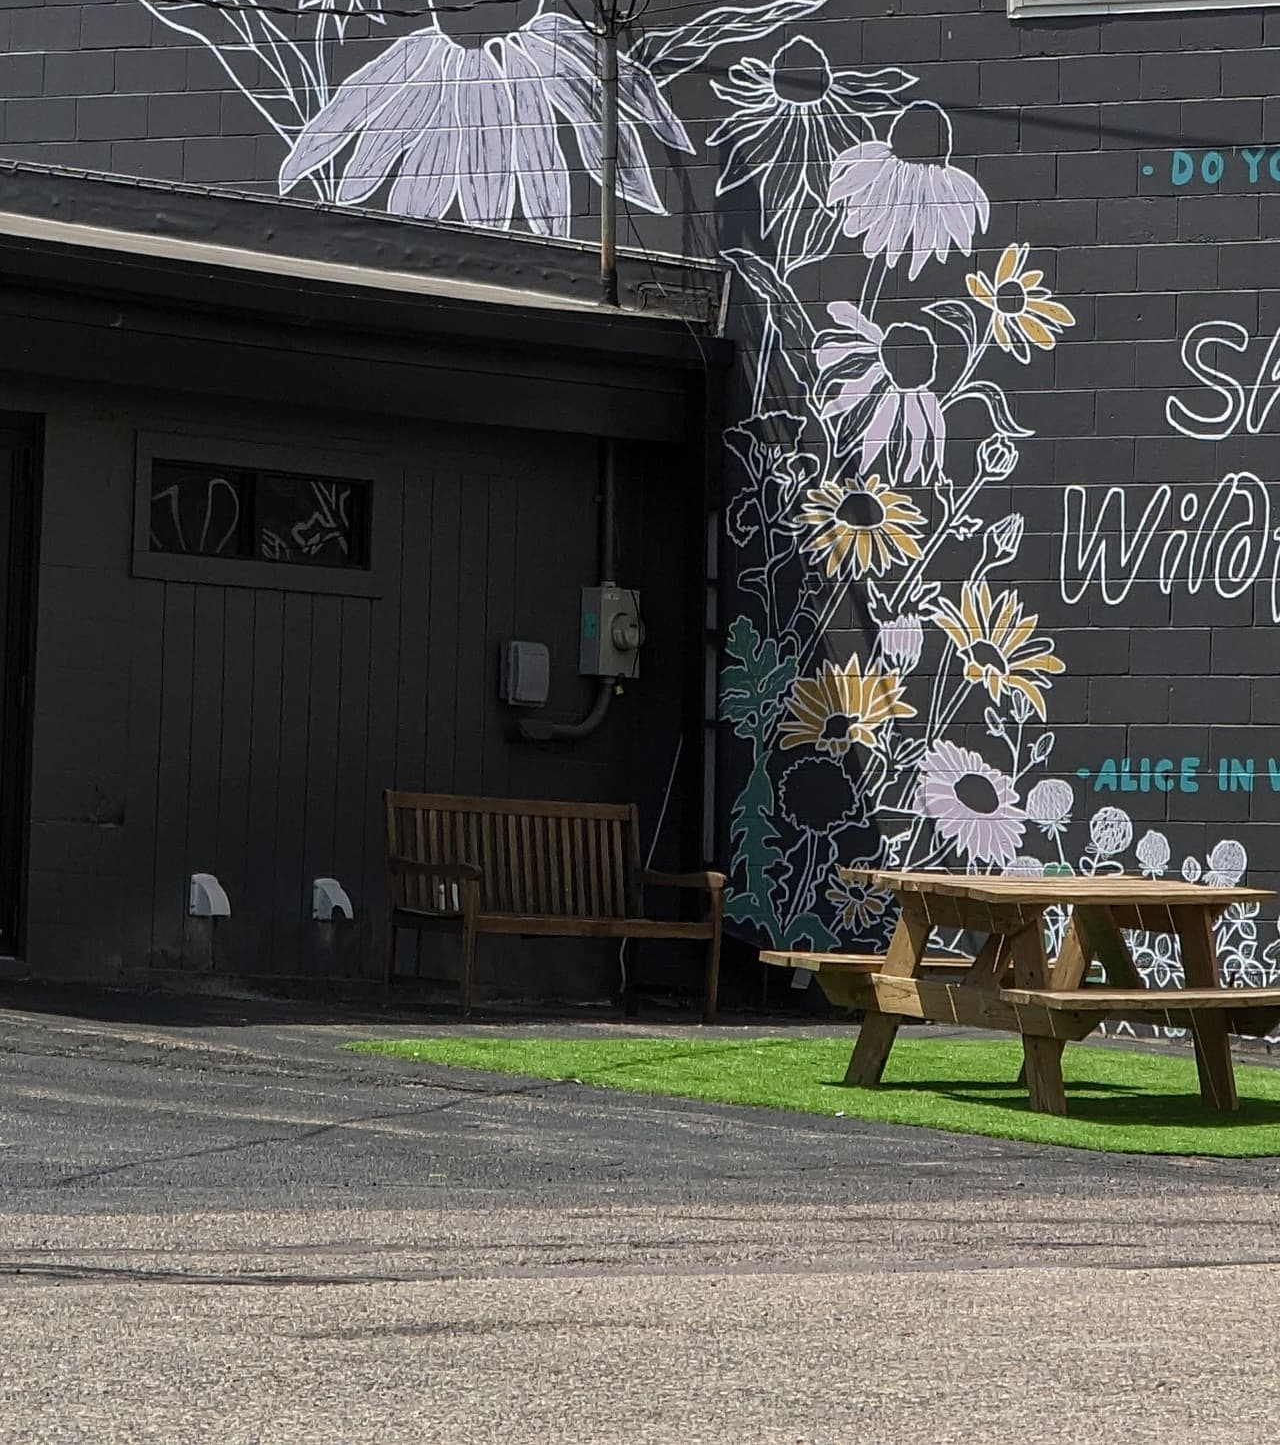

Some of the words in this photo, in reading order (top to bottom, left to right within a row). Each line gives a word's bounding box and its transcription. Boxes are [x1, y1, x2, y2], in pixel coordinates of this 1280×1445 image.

[1170, 148, 1224, 186] DO
[1093, 757, 1201, 793] ALICE
[1218, 757, 1255, 793] IN
